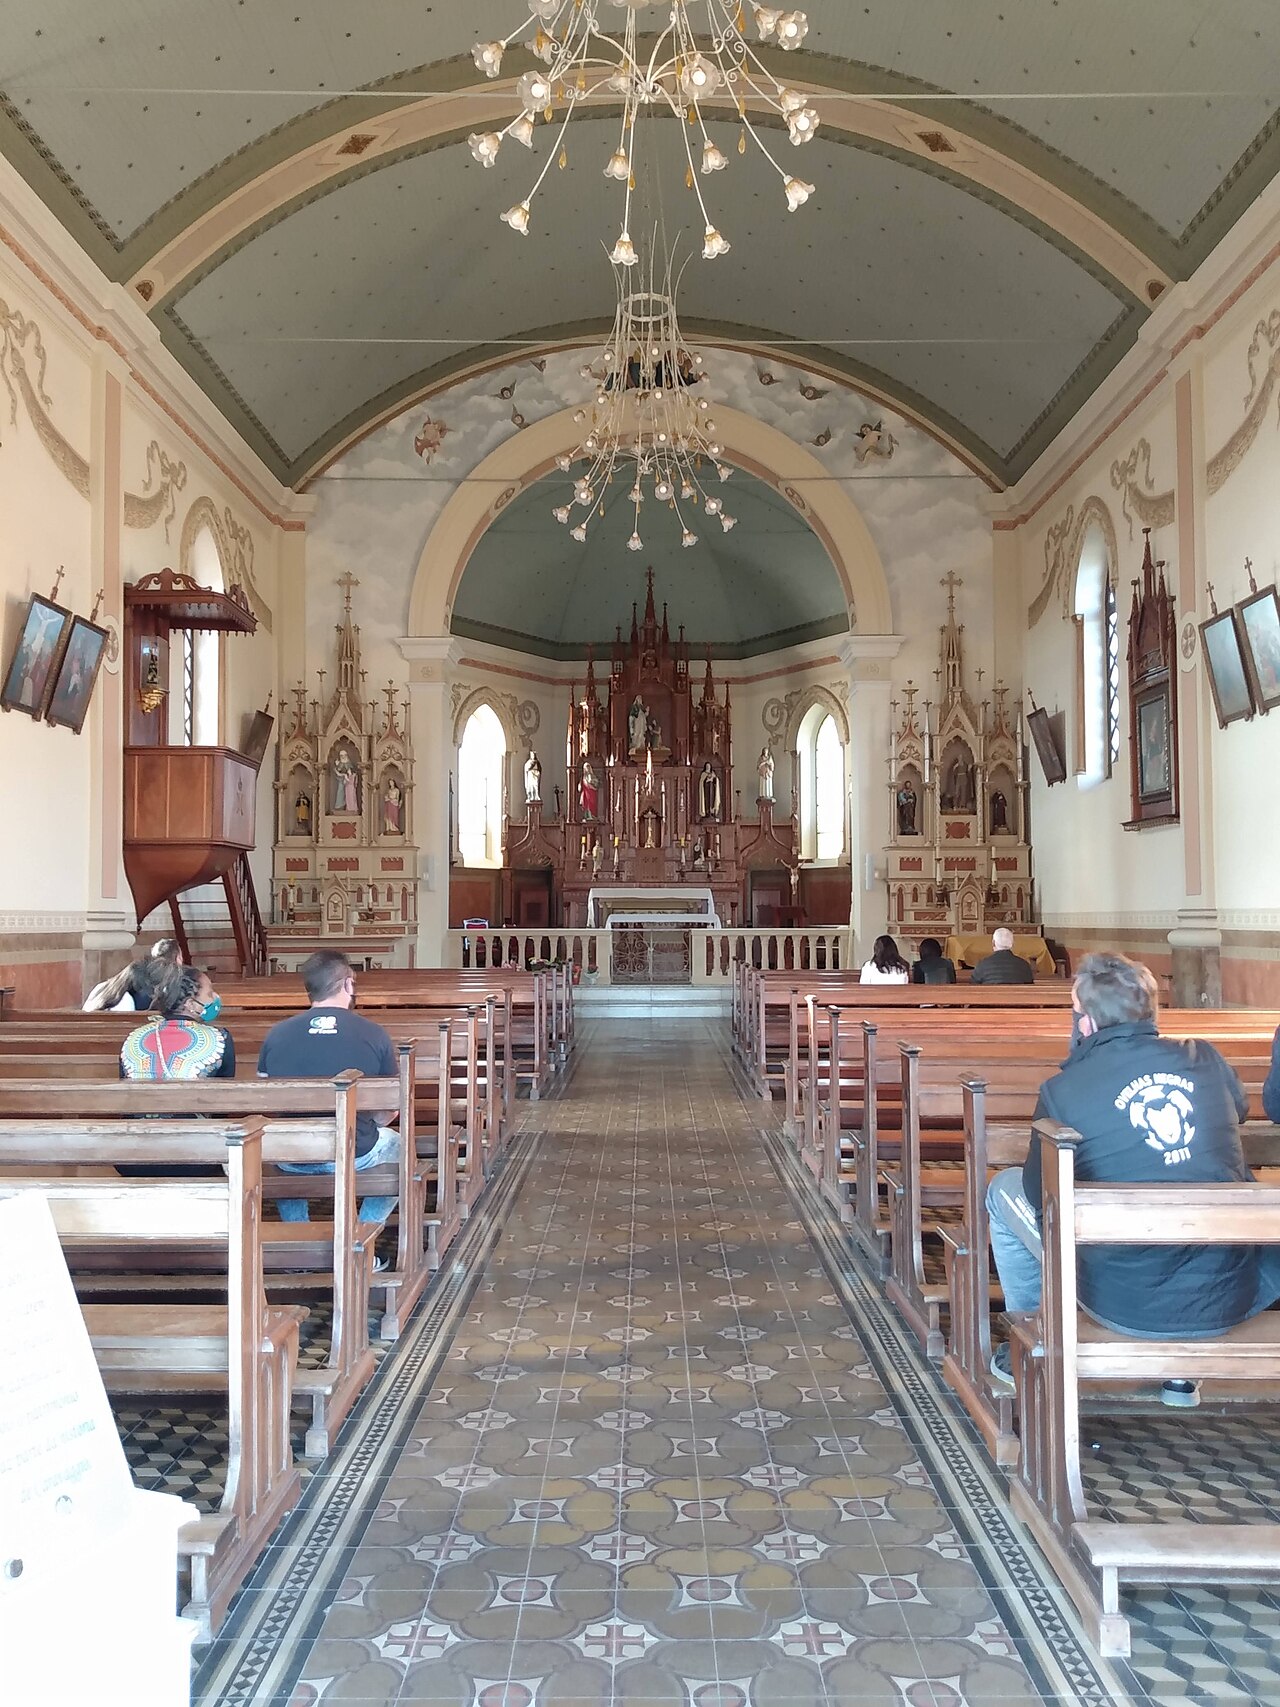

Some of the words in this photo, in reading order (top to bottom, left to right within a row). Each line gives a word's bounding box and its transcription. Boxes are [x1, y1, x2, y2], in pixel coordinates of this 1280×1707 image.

[1114, 1074, 1153, 1110] OVELHAS
[1152, 1072, 1194, 1093] NEGRAS
[1163, 1147, 1192, 1166] 2011
